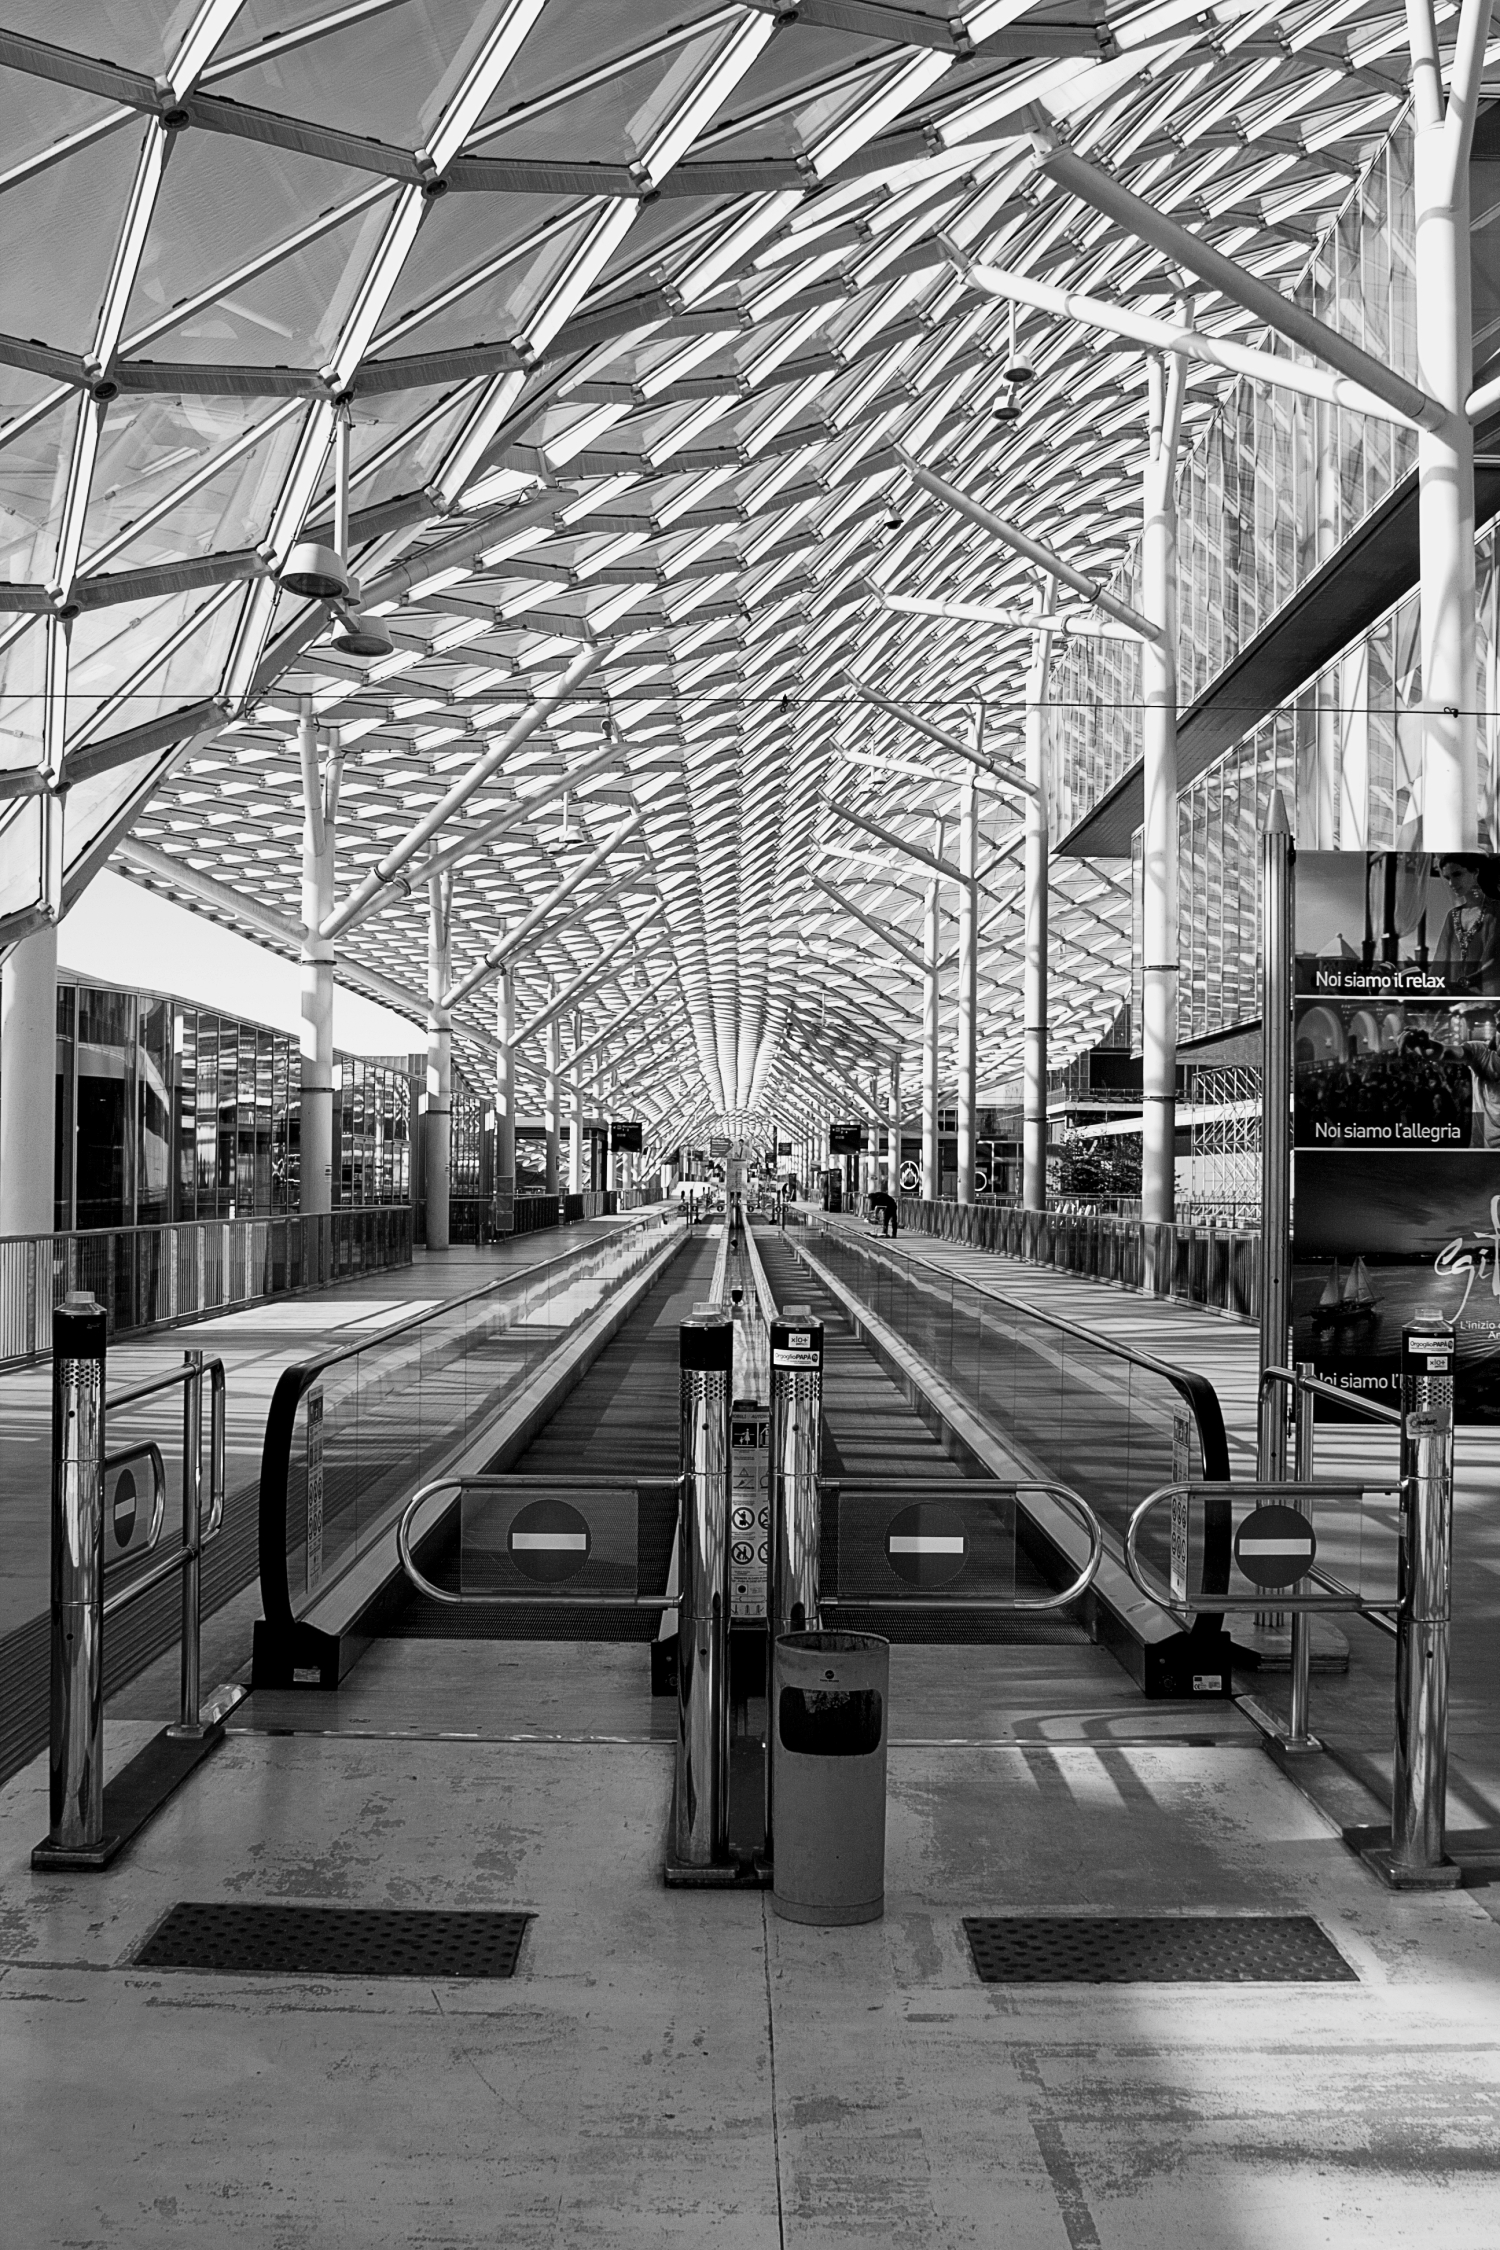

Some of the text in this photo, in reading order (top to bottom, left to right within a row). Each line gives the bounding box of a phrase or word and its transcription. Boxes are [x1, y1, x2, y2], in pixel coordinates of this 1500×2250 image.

[1315, 971, 1446, 988] Noi siamo il relax
[1315, 1122, 1461, 1143] Noi siamo l'allegria
[1460, 1320, 1496, 1330] L'inizio
[1340, 1372, 1389, 1389] siamo
